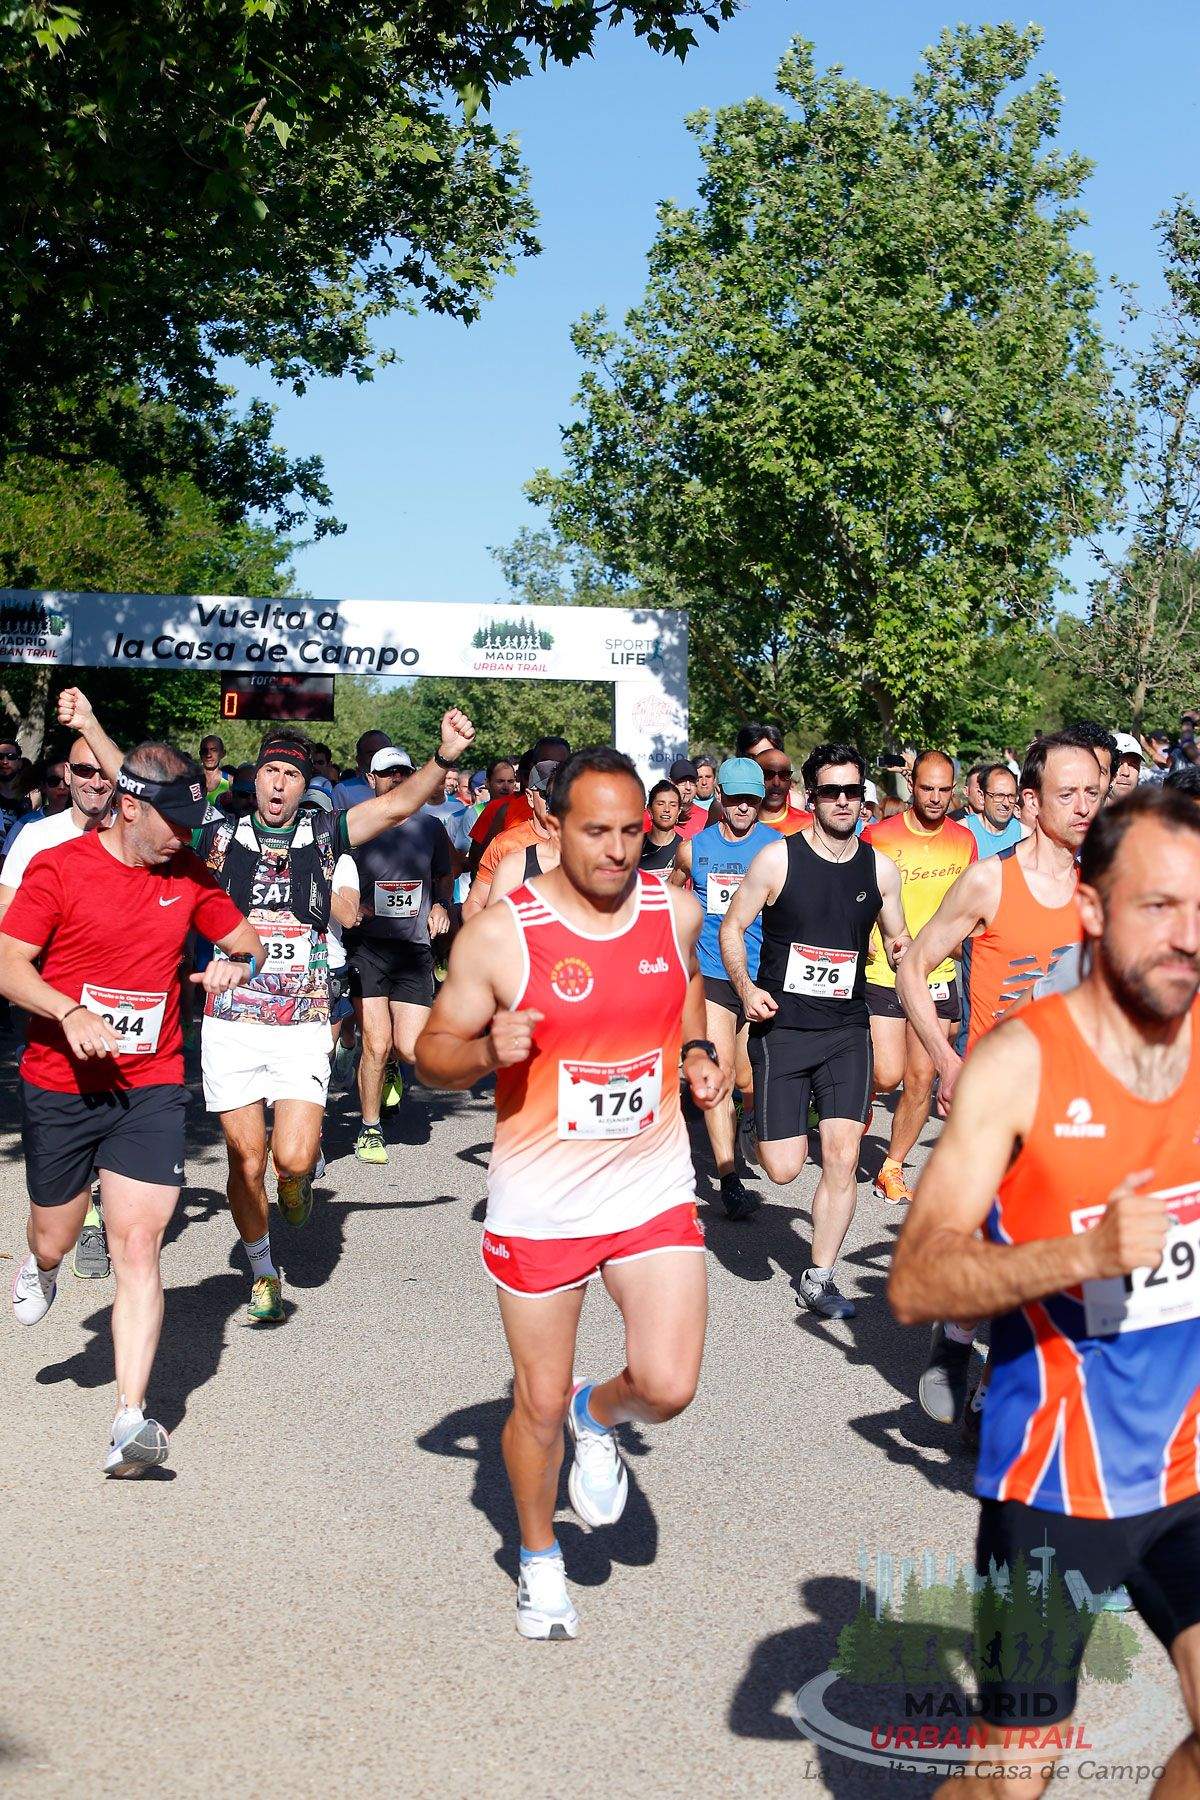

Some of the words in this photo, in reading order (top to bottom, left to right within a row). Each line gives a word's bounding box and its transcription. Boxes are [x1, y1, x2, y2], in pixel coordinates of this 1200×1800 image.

[197, 603, 306, 630] Vuelta
[317, 611, 339, 631] a
[605, 638, 652, 650] SPORT
[26, 648, 58, 658] TRAIL
[112, 632, 145, 658] la
[152, 635, 235, 661] Casa
[246, 638, 288, 663] de
[300, 639, 420, 672] Campo
[485, 651, 537, 661] MADRID
[611, 652, 646, 665] LIFE
[473, 662, 513, 672] URBAN
[518, 663, 548, 673] TRAIL
[386, 894, 412, 907] 354
[720, 888, 733, 903] 9
[803, 964, 840, 984] 376
[588, 1086, 643, 1116] 176
